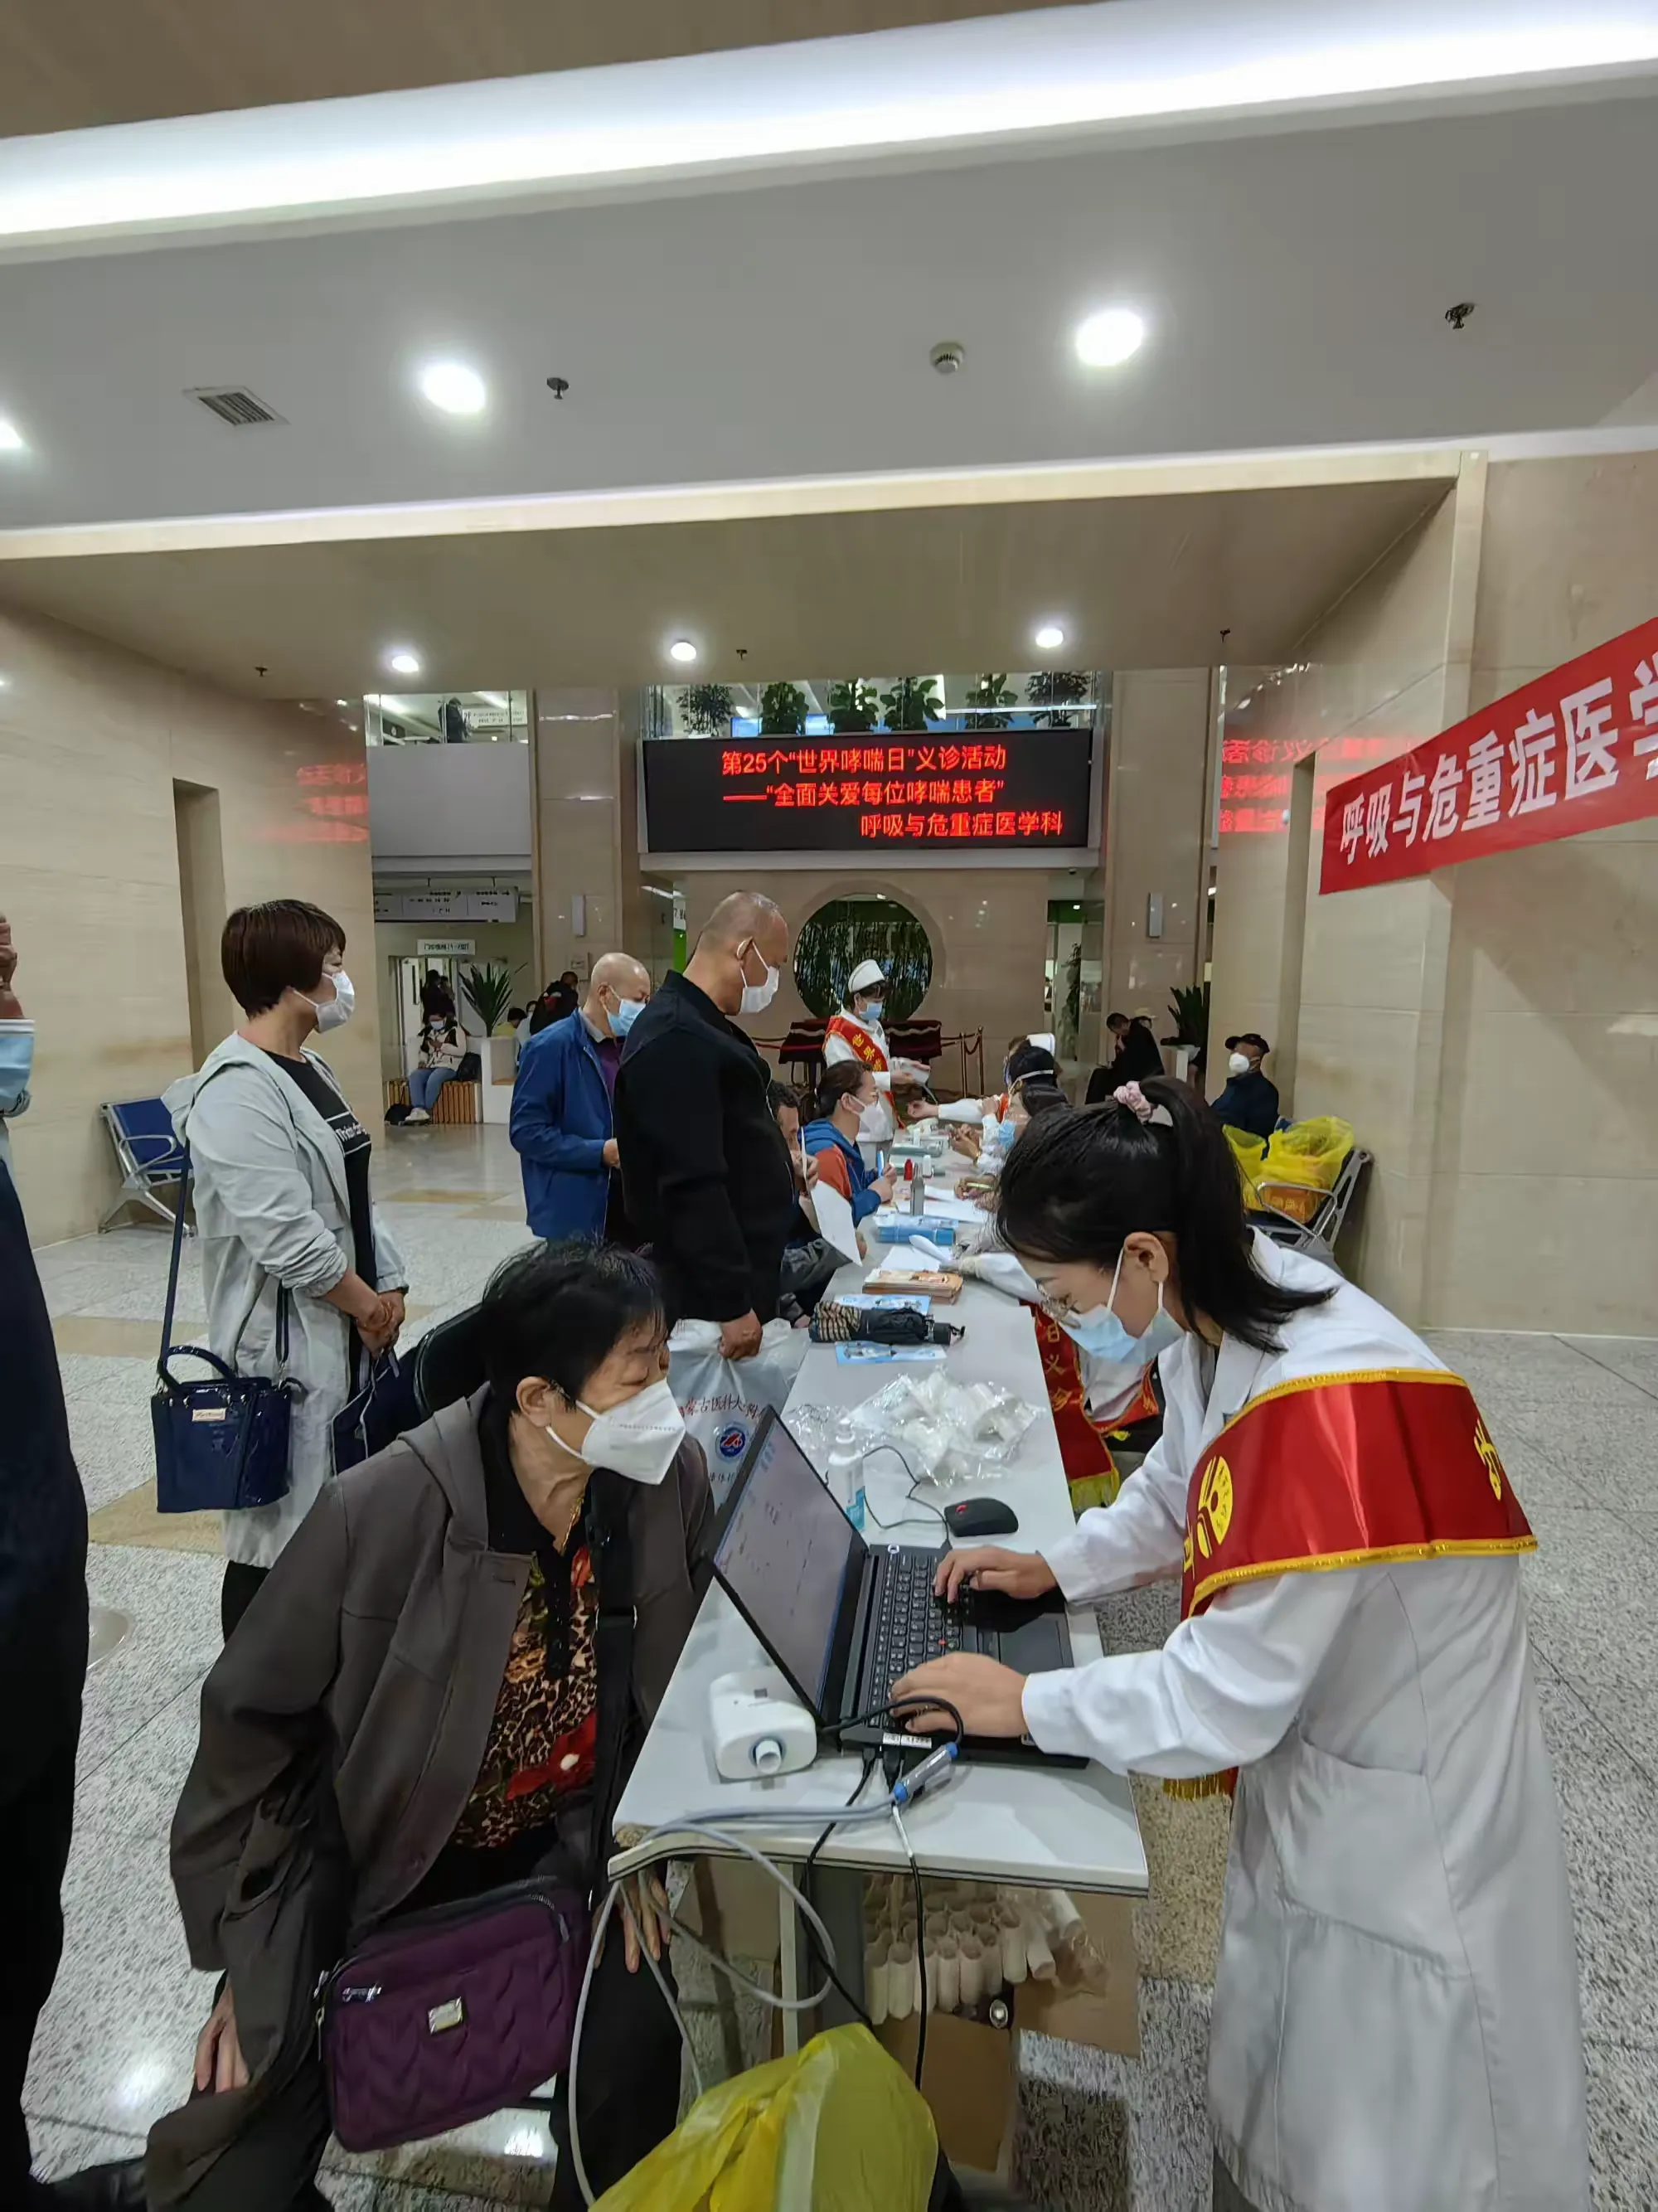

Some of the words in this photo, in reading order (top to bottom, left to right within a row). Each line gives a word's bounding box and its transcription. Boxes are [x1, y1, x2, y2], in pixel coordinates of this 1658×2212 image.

[860, 809, 1064, 838] 呼吸与危重症医学科
